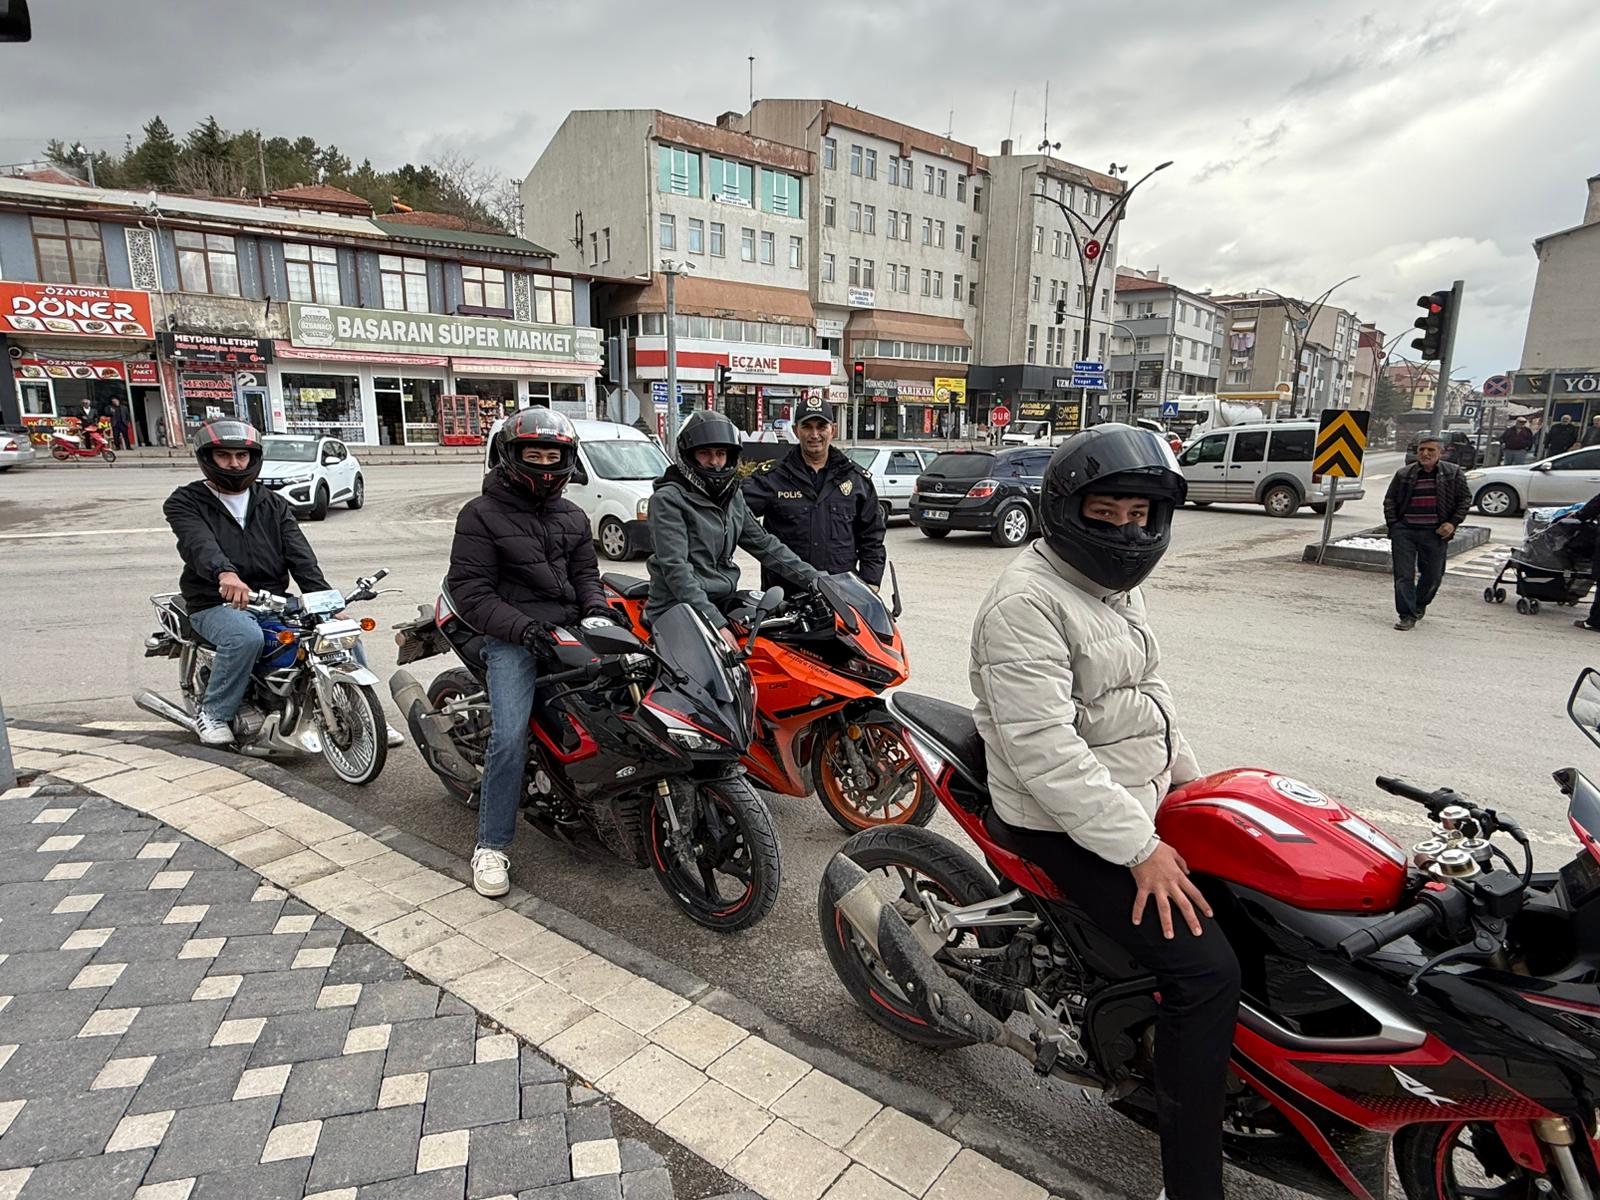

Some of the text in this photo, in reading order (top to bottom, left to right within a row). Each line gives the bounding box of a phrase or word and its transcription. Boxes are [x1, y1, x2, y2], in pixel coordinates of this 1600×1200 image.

[12, 296, 137, 321] DÖNER
[174, 334, 217, 344] MEYDAN
[337, 316, 572, 353] BAŞARAN SÜPER MARKET
[732, 355, 778, 370] ECZANE
[897, 386, 934, 395] SARIKAYA
[1563, 374, 1600, 392] YÖ
[1466, 407, 1475, 415] D
